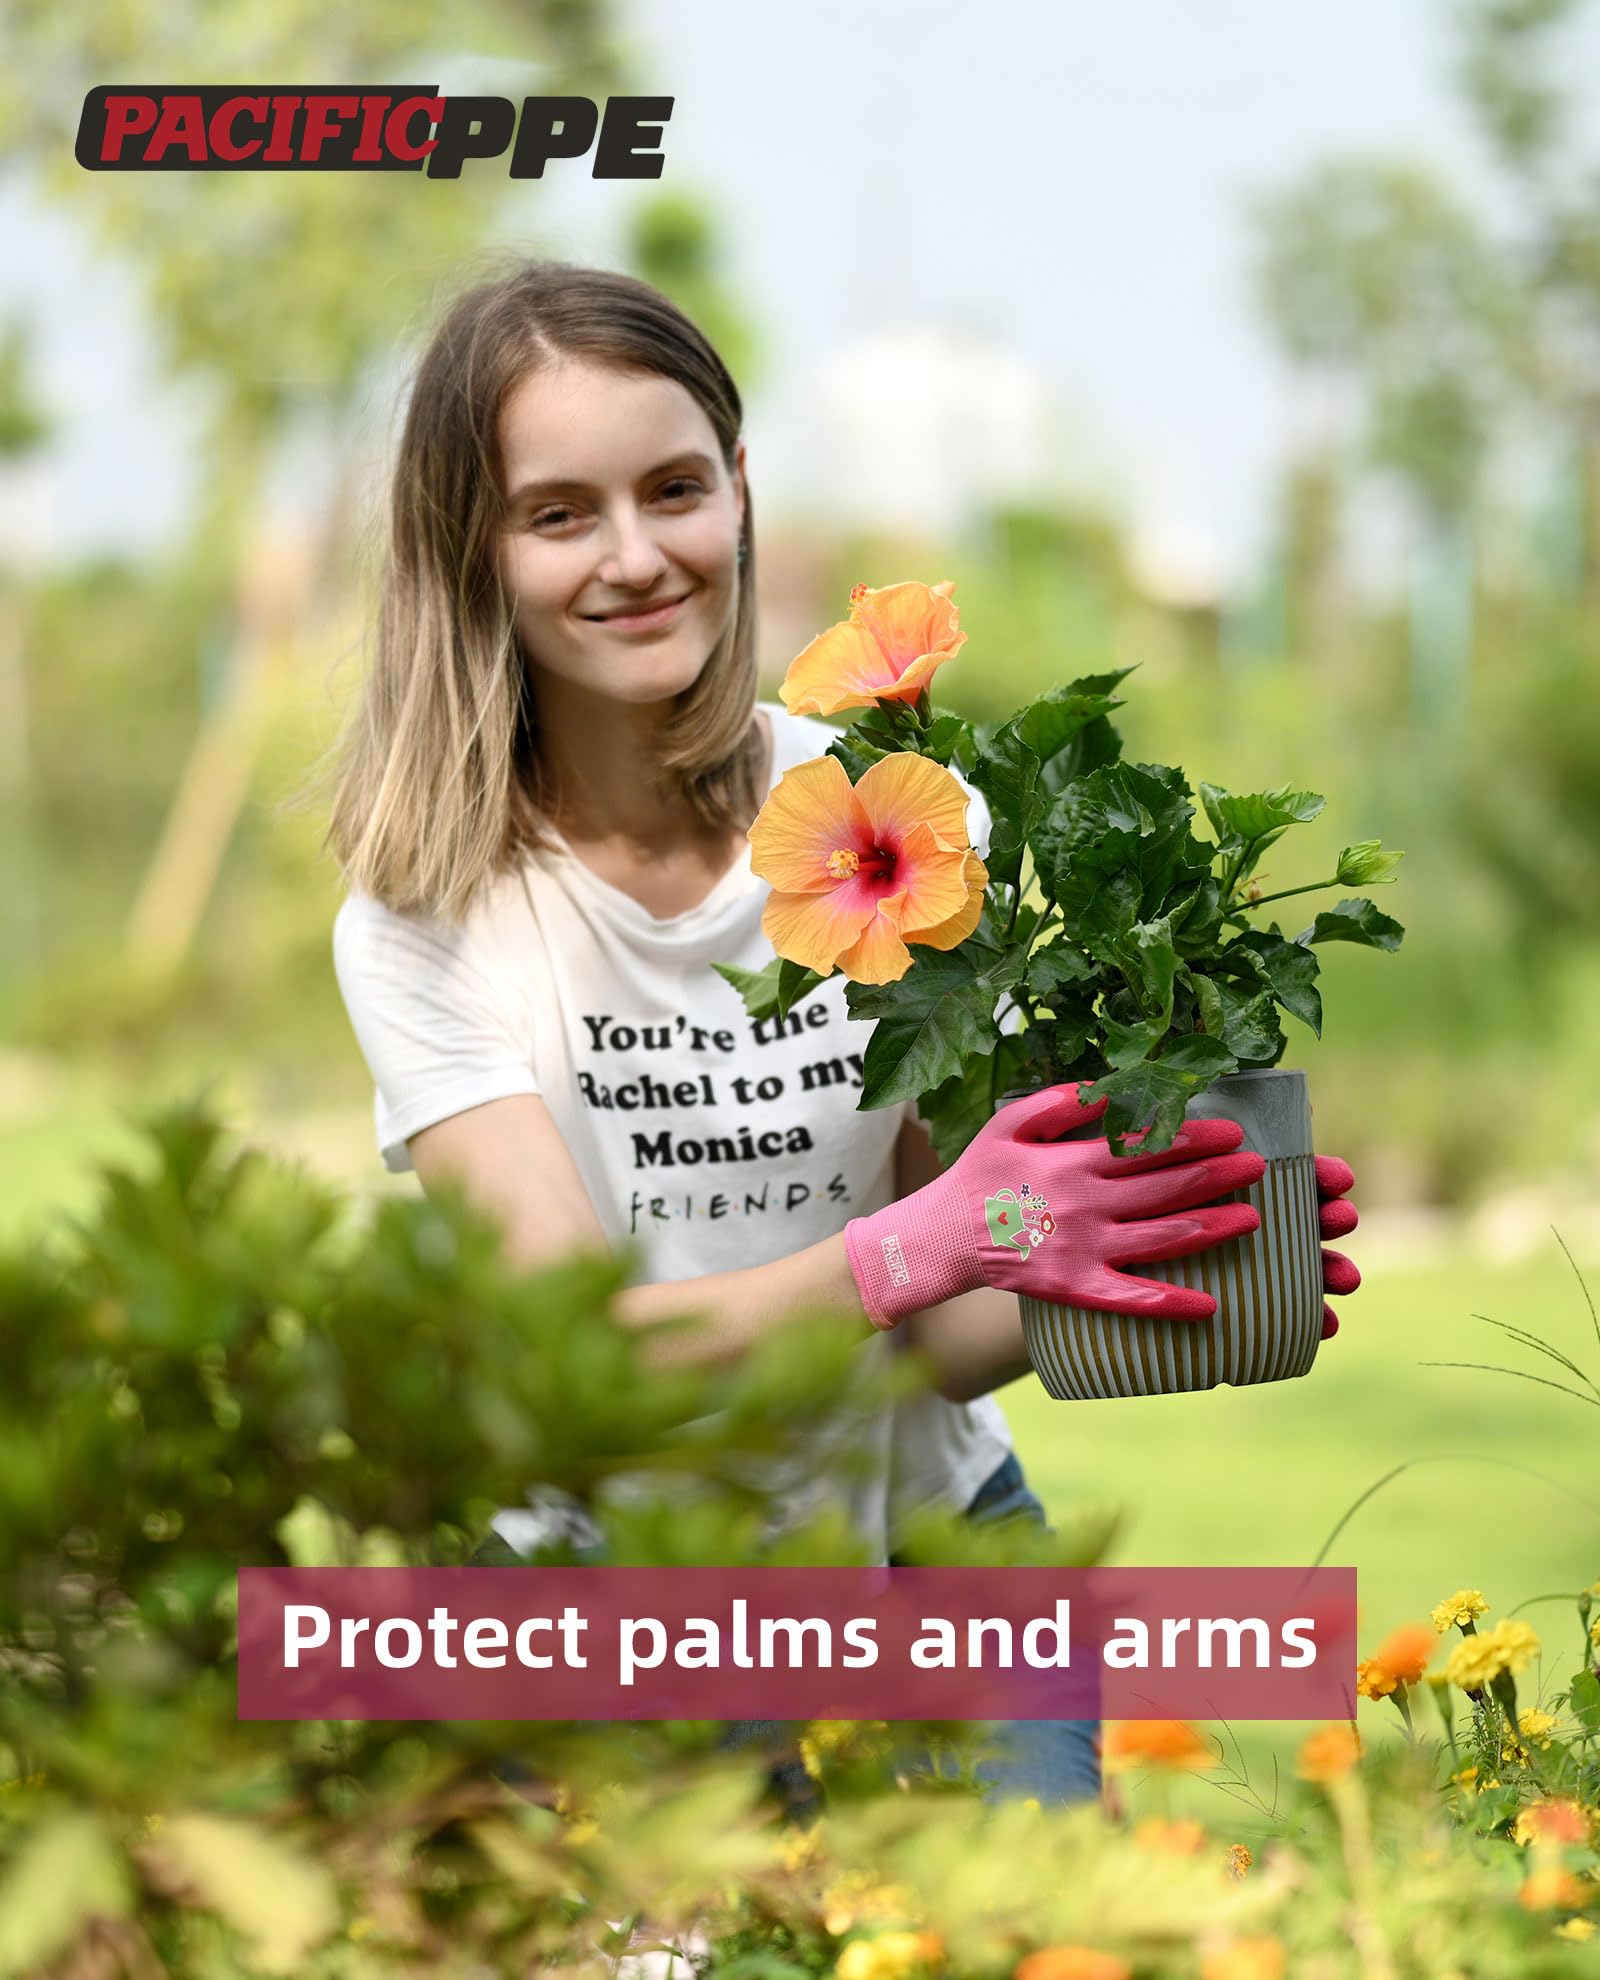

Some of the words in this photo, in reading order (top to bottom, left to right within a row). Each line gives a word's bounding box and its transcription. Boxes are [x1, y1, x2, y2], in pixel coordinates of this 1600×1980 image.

[582, 1014, 736, 1052] You're
[750, 1003, 830, 1046] the
[577, 1071, 717, 1111] Rachel
[730, 1075, 785, 1105] to
[799, 1053, 864, 1091] my
[630, 1125, 815, 1169] Monica
